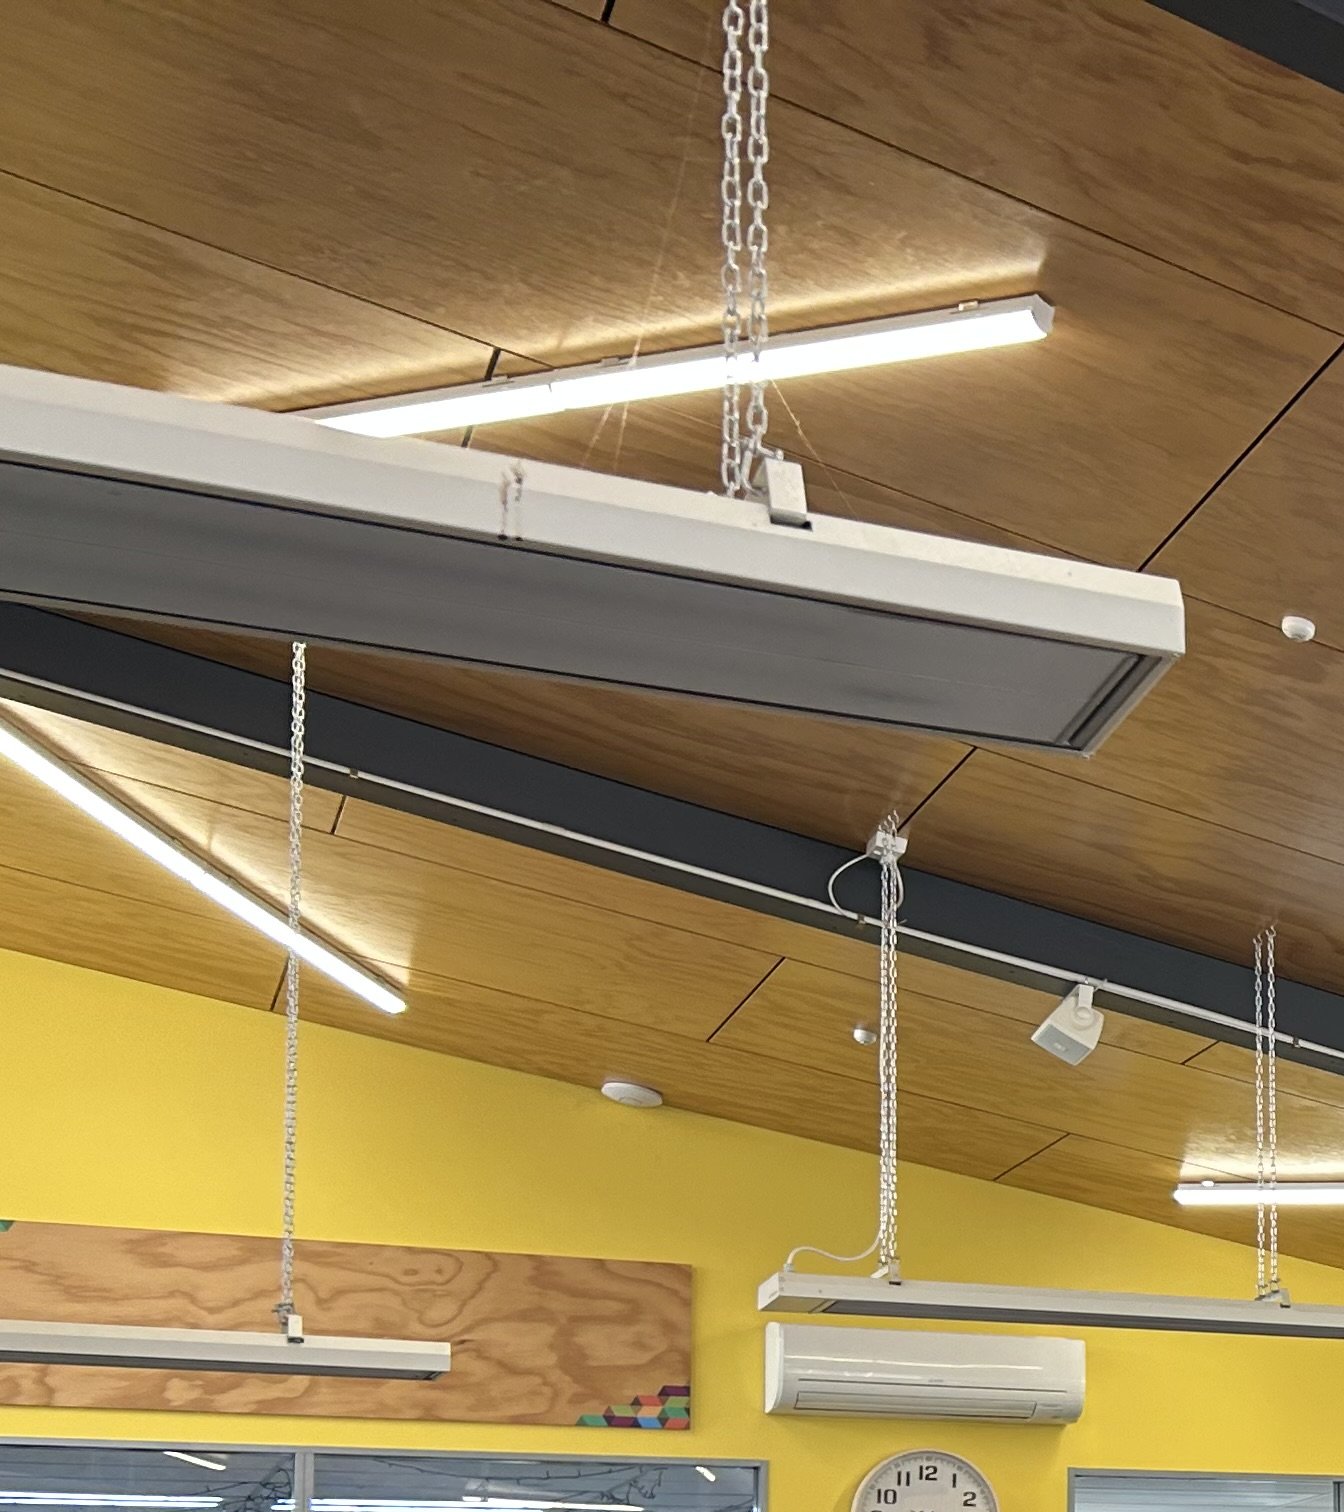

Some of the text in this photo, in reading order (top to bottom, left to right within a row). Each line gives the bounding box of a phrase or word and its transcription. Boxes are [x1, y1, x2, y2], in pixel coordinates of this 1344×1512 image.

[897, 1471, 910, 1486] 11
[919, 1465, 938, 1481] 12
[952, 1473, 957, 1488] 1
[877, 1489, 897, 1505] 10
[963, 1492, 977, 1507] 2
